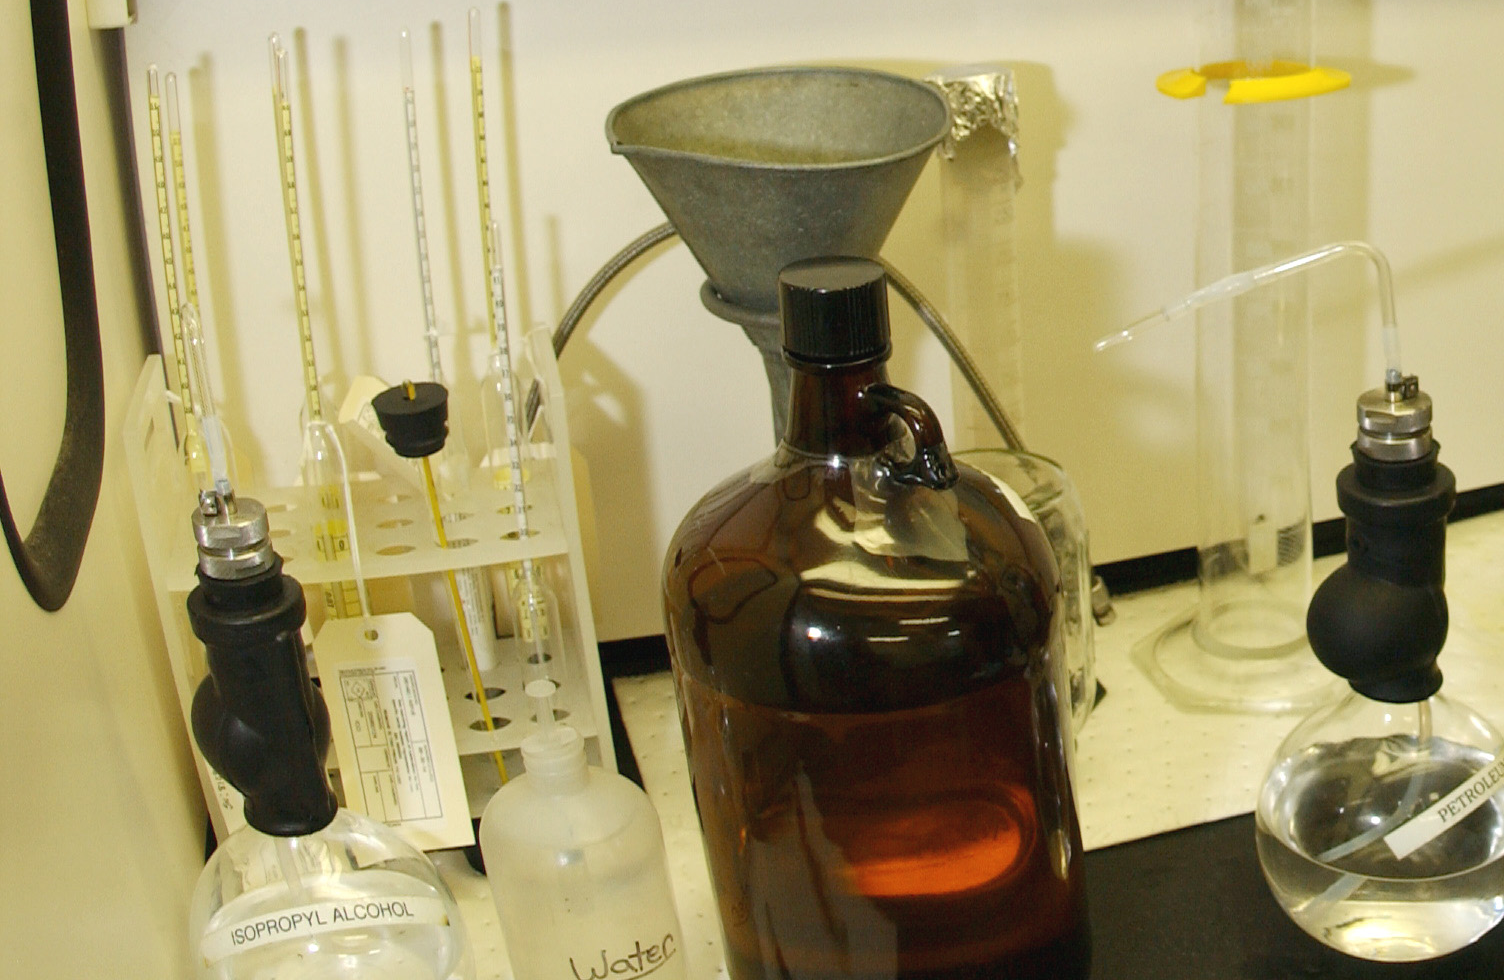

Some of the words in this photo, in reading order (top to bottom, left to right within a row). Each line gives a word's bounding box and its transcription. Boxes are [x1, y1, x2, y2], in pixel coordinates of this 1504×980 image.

[231, 911, 327, 946] ISOPROPYL
[333, 901, 415, 923] ALCOHOL
[569, 933, 676, 980] Water
